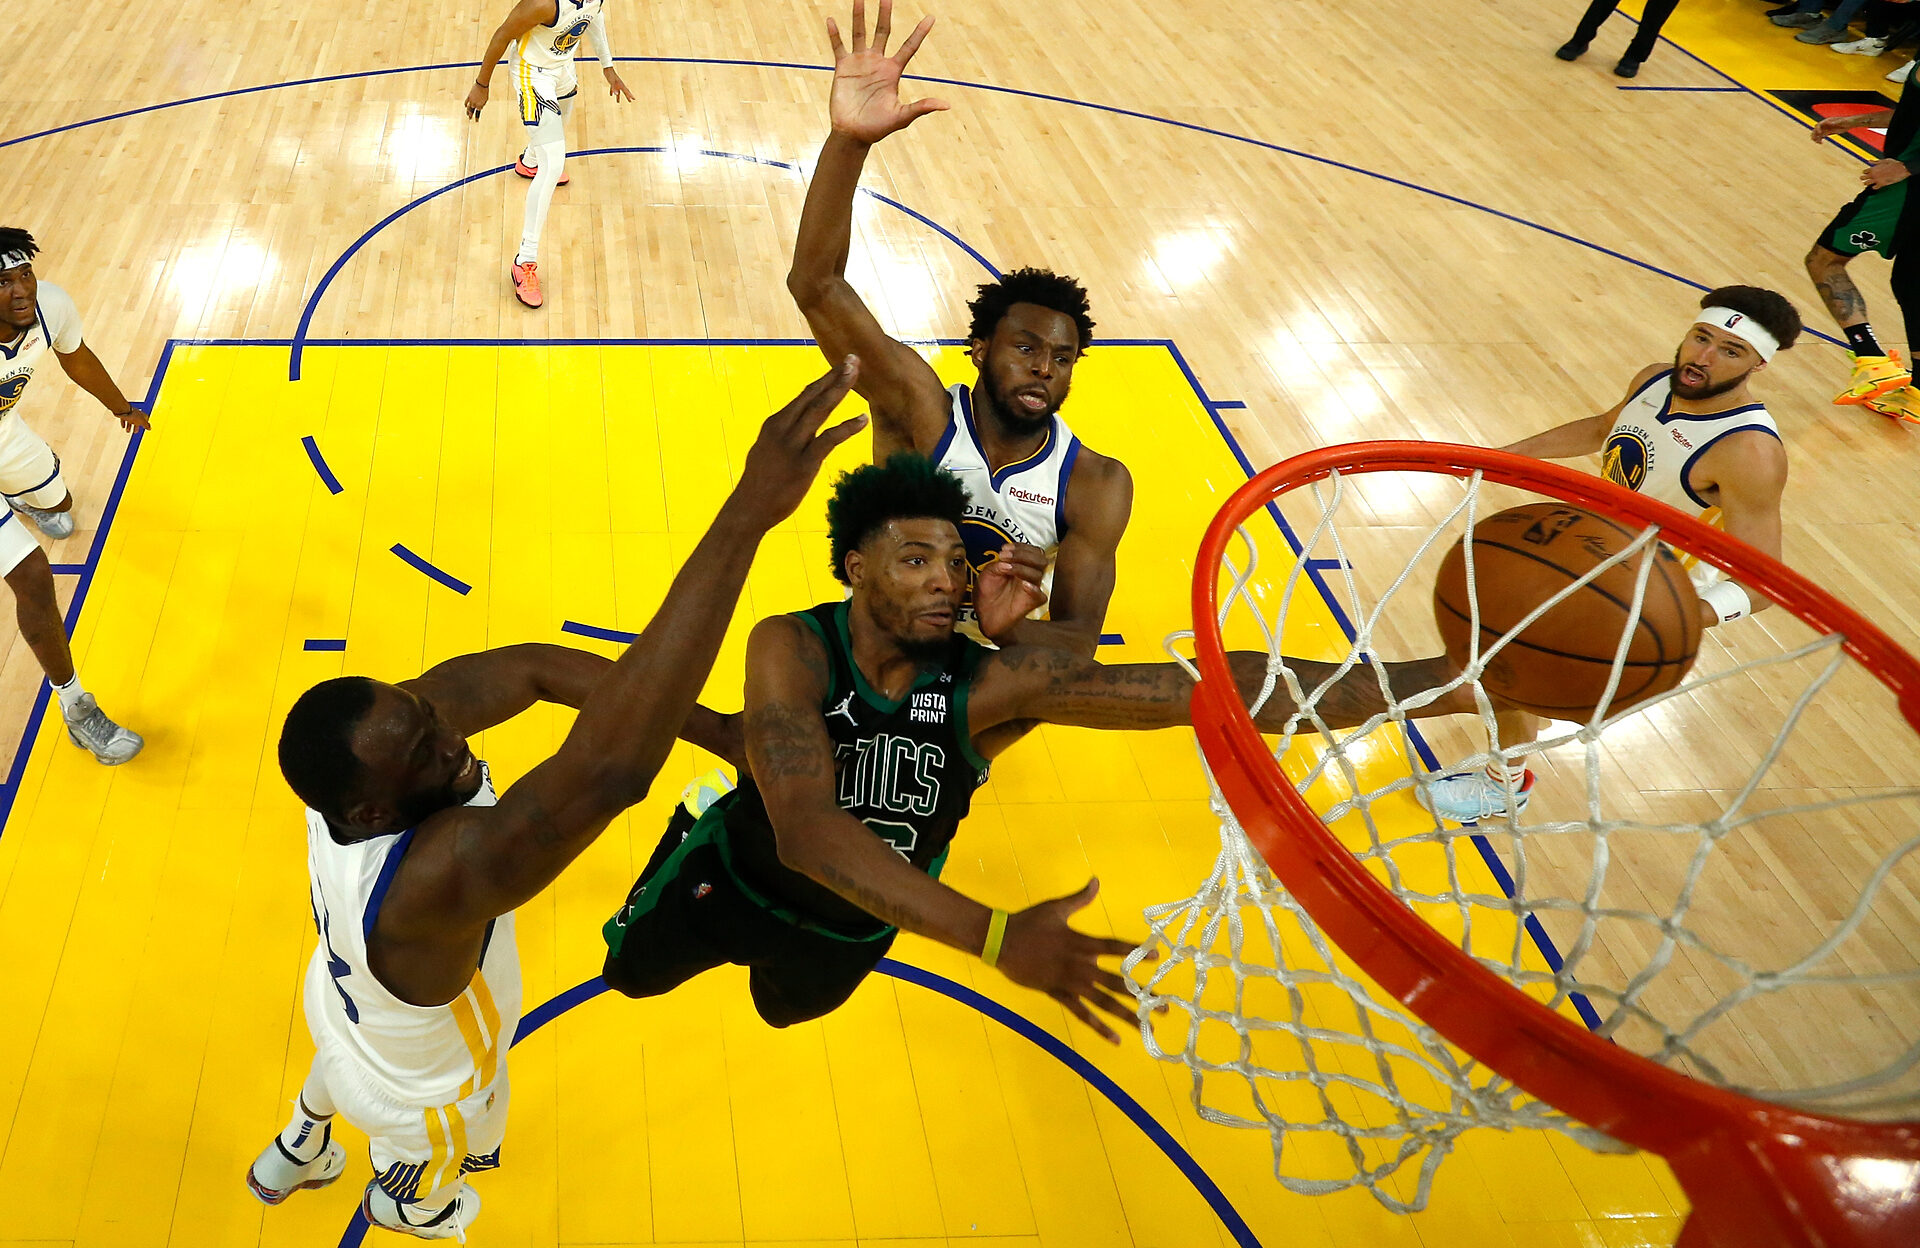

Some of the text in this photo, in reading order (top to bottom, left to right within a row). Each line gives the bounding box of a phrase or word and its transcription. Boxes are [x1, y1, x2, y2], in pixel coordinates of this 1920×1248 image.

[12, 382, 23, 396] 5
[1671, 428, 1693, 450] Rakuten
[1614, 424, 1656, 472] GOLDEN STATE
[1009, 486, 1055, 507] Rakuten
[963, 504, 997, 520] DEN
[939, 672, 952, 683] 24
[912, 693, 947, 712] VISTA
[910, 708, 947, 724] PRINT
